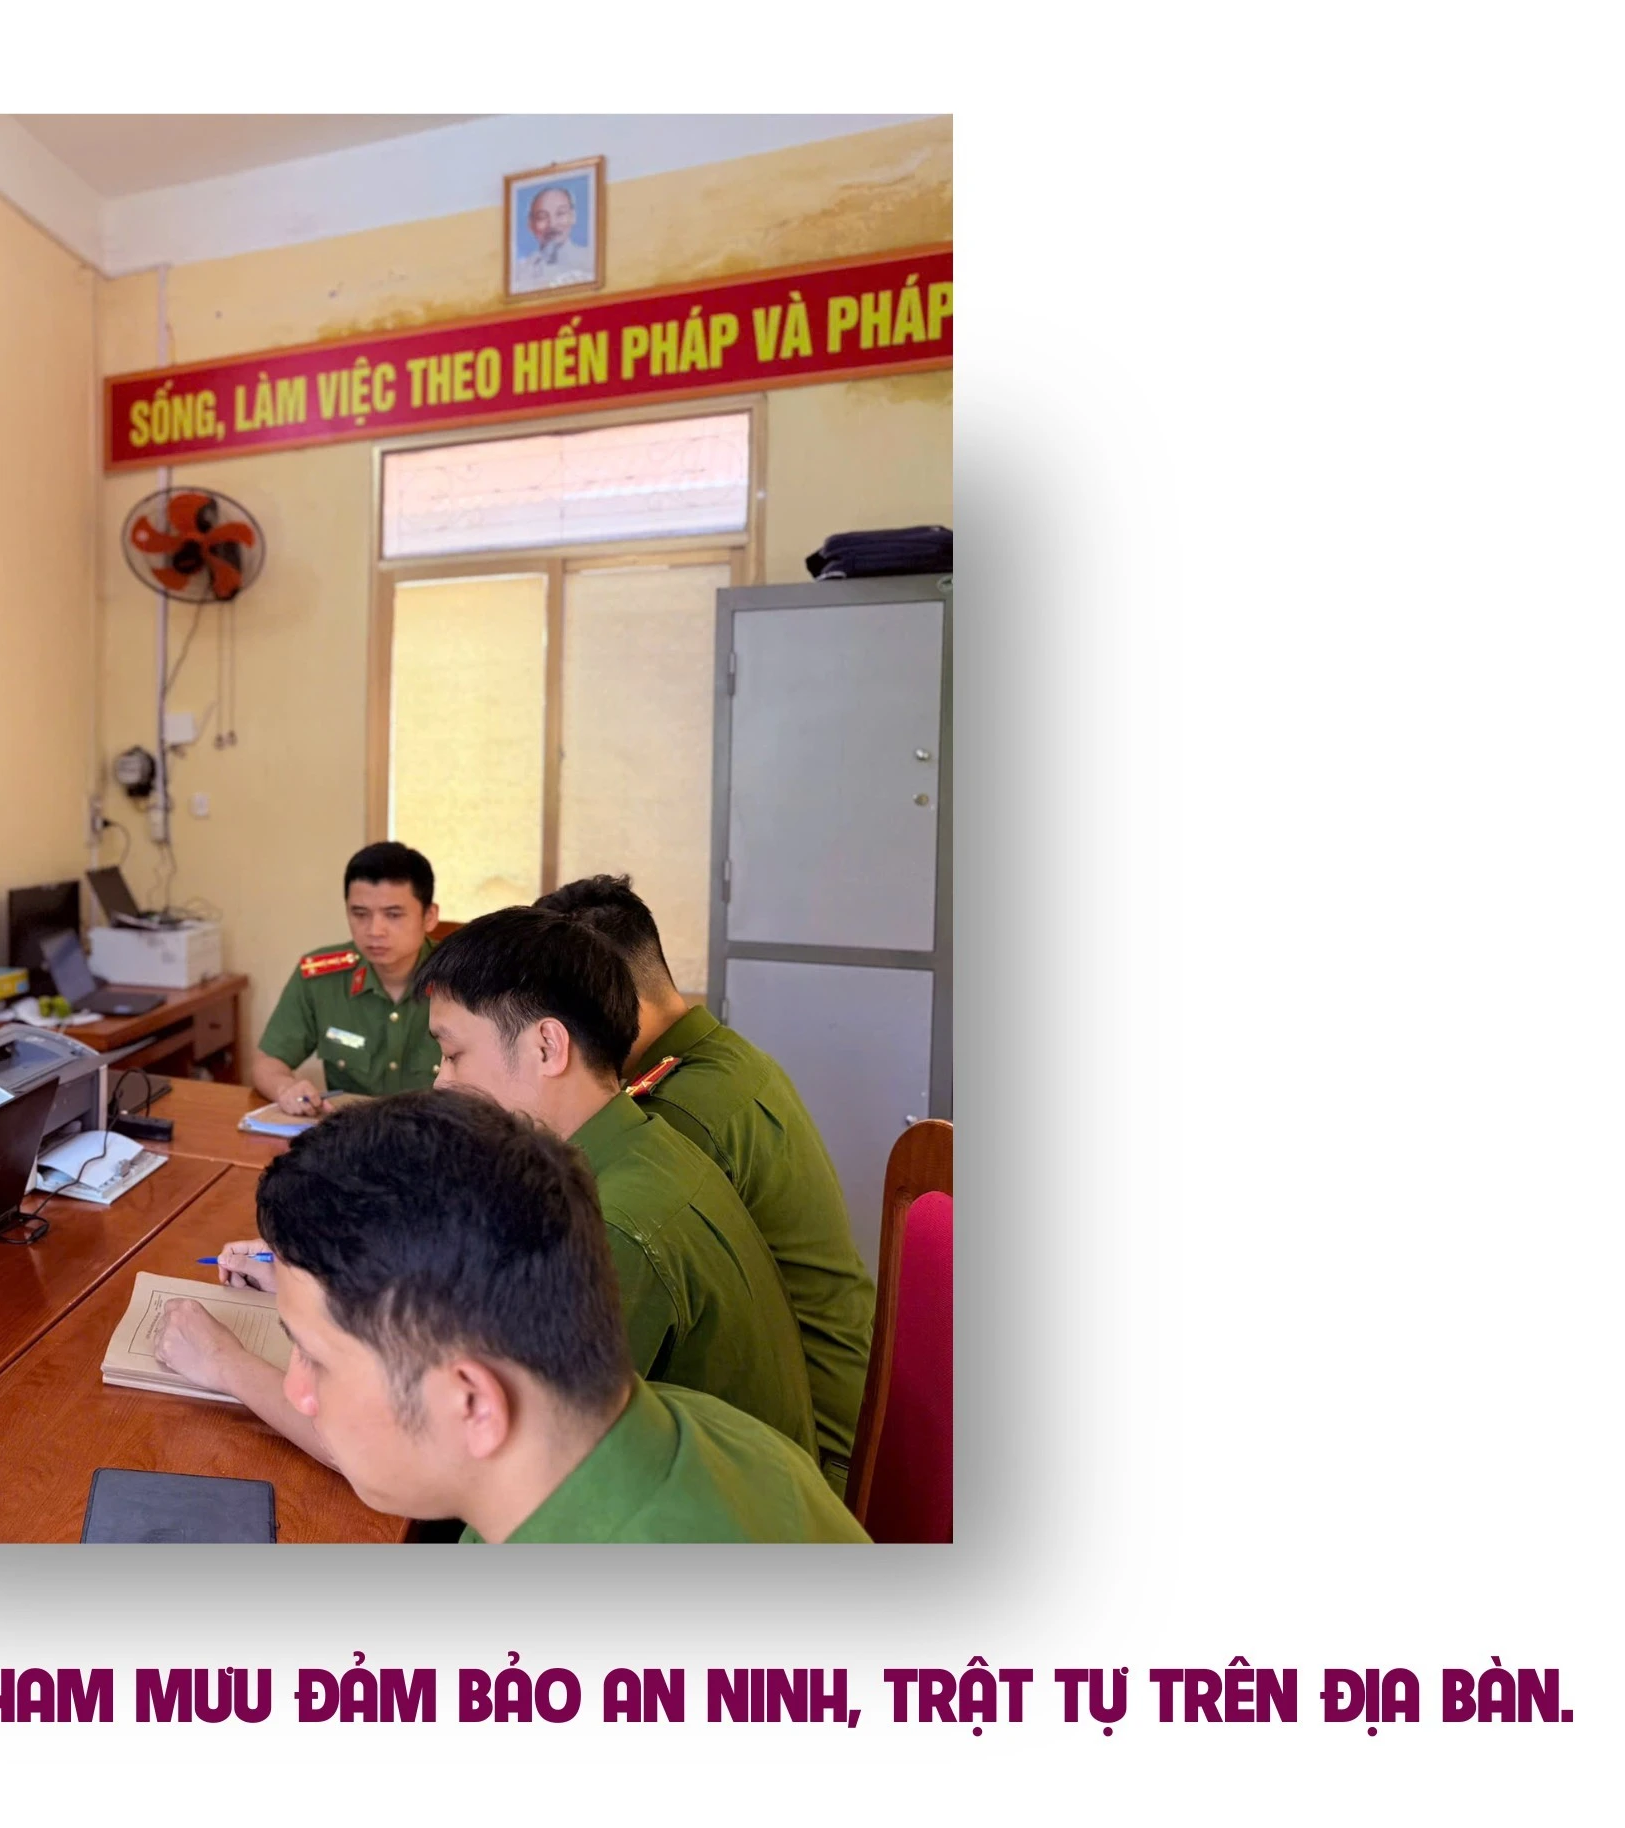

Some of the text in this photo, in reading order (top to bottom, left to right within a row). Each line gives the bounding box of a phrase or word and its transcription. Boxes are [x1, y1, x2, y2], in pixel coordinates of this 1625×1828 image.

[130, 274, 953, 447] SỐNG, LÀM VIỆC THEO HIẾN PHÁP VÀ PHÁP
